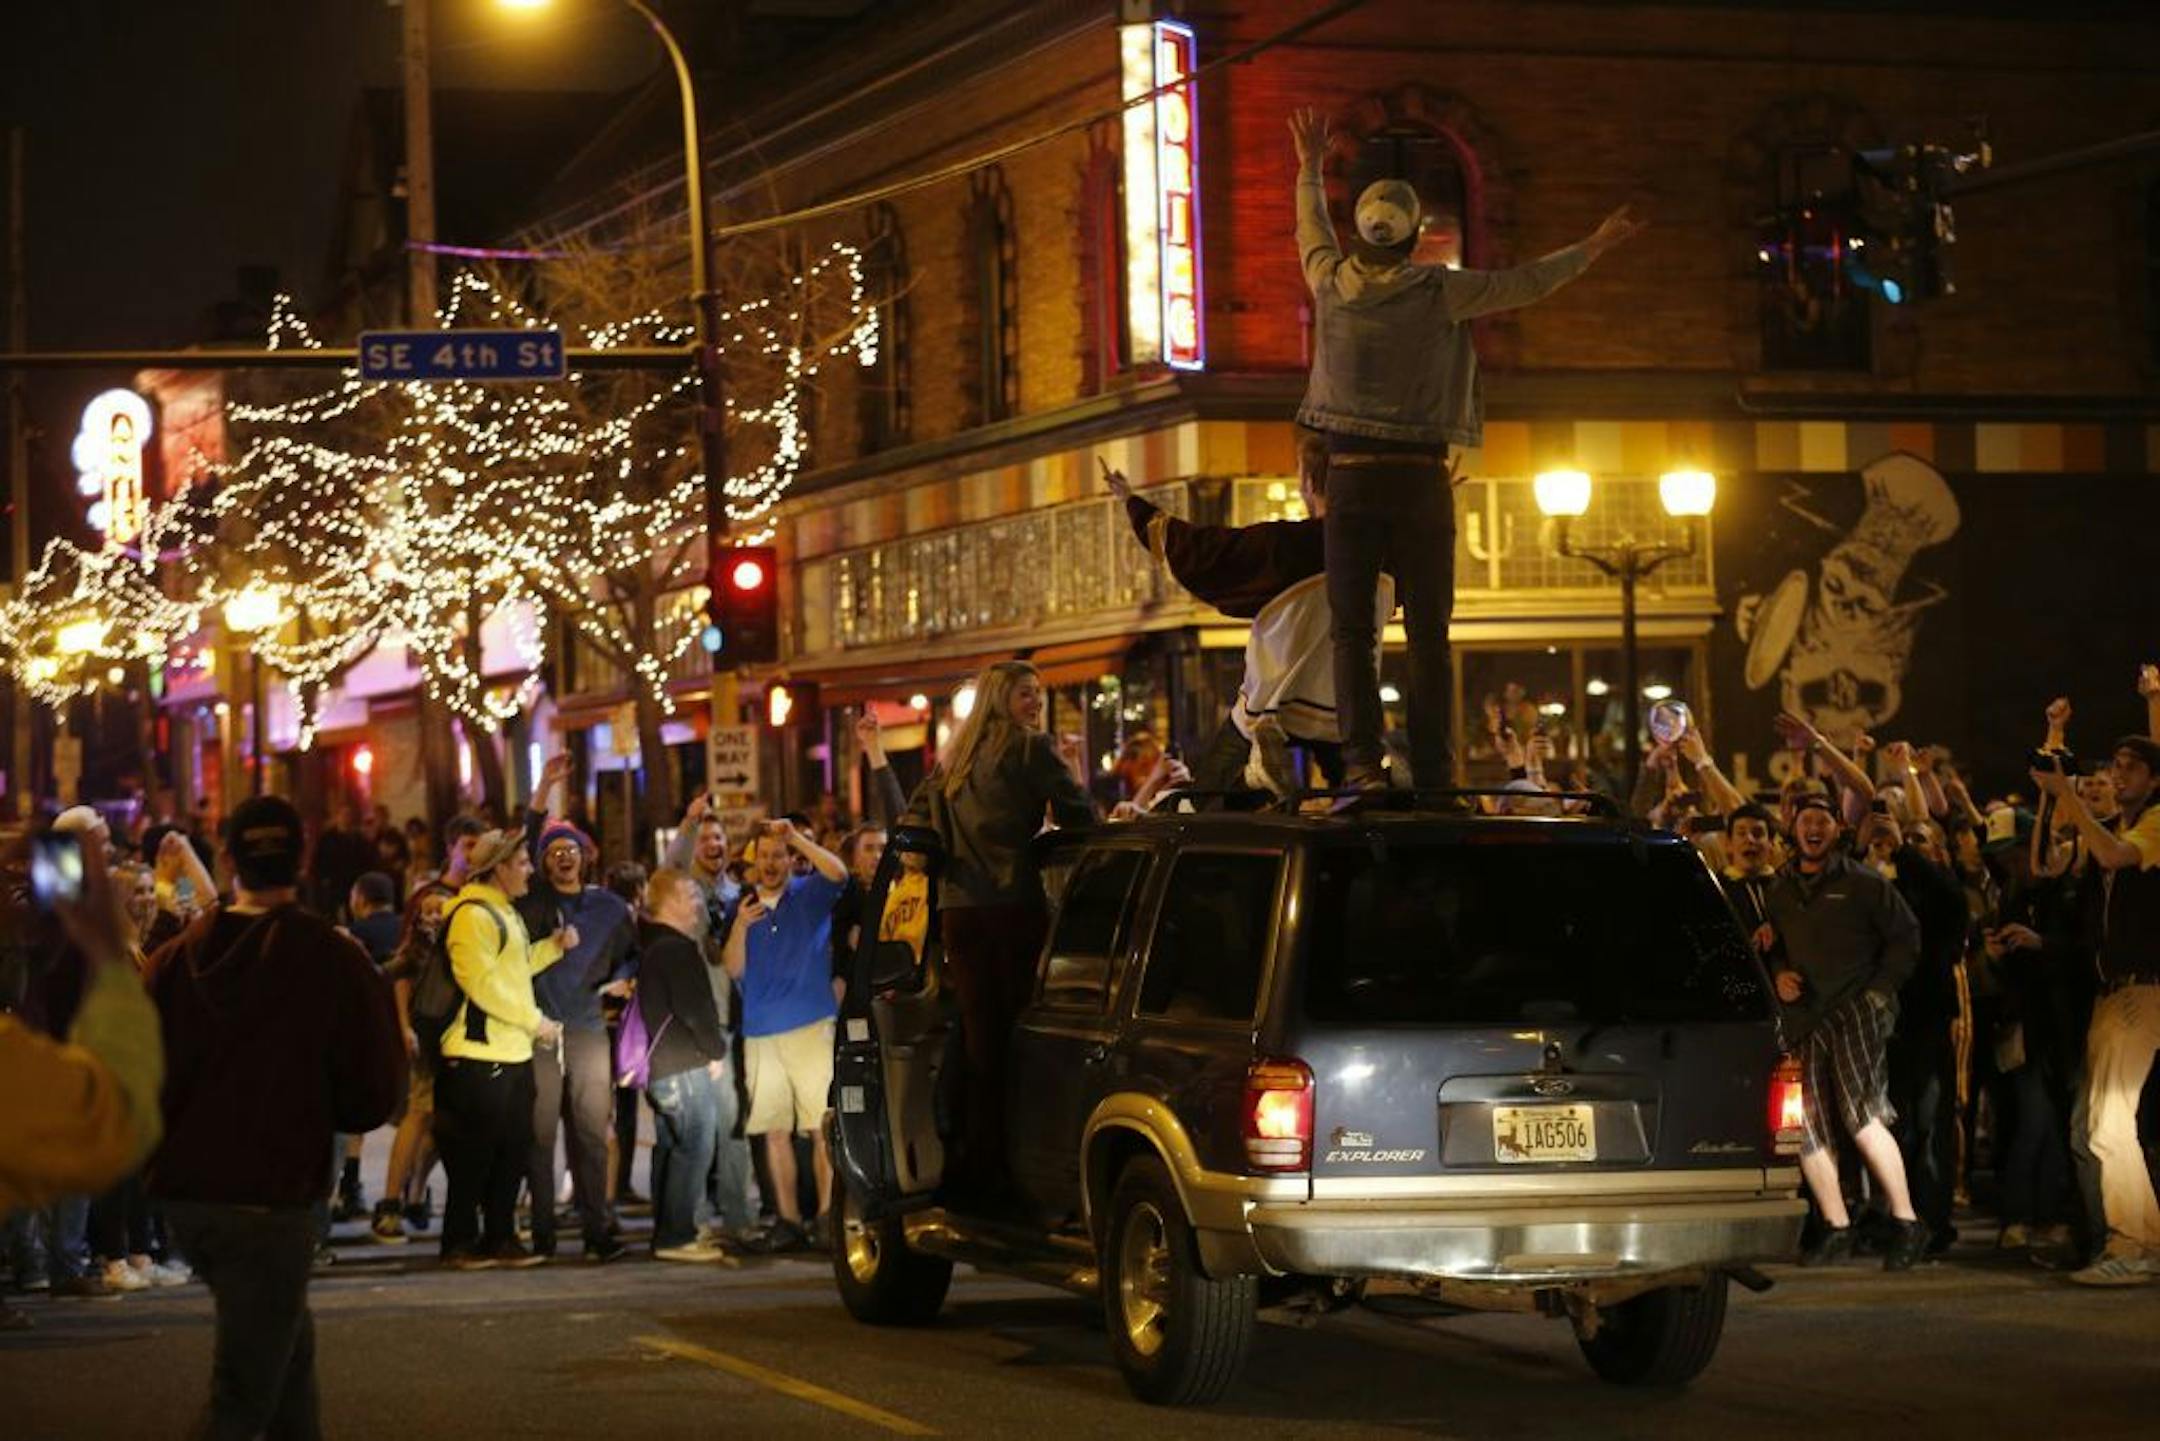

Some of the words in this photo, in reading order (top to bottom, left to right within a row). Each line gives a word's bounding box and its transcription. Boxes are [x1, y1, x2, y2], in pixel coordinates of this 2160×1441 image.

[368, 344, 412, 371] SE
[432, 344, 498, 369] 4th
[518, 341, 555, 368] St
[714, 731, 753, 746] ONE
[715, 751, 750, 765] WAY
[1325, 1149, 1426, 1163] EXPLORER
